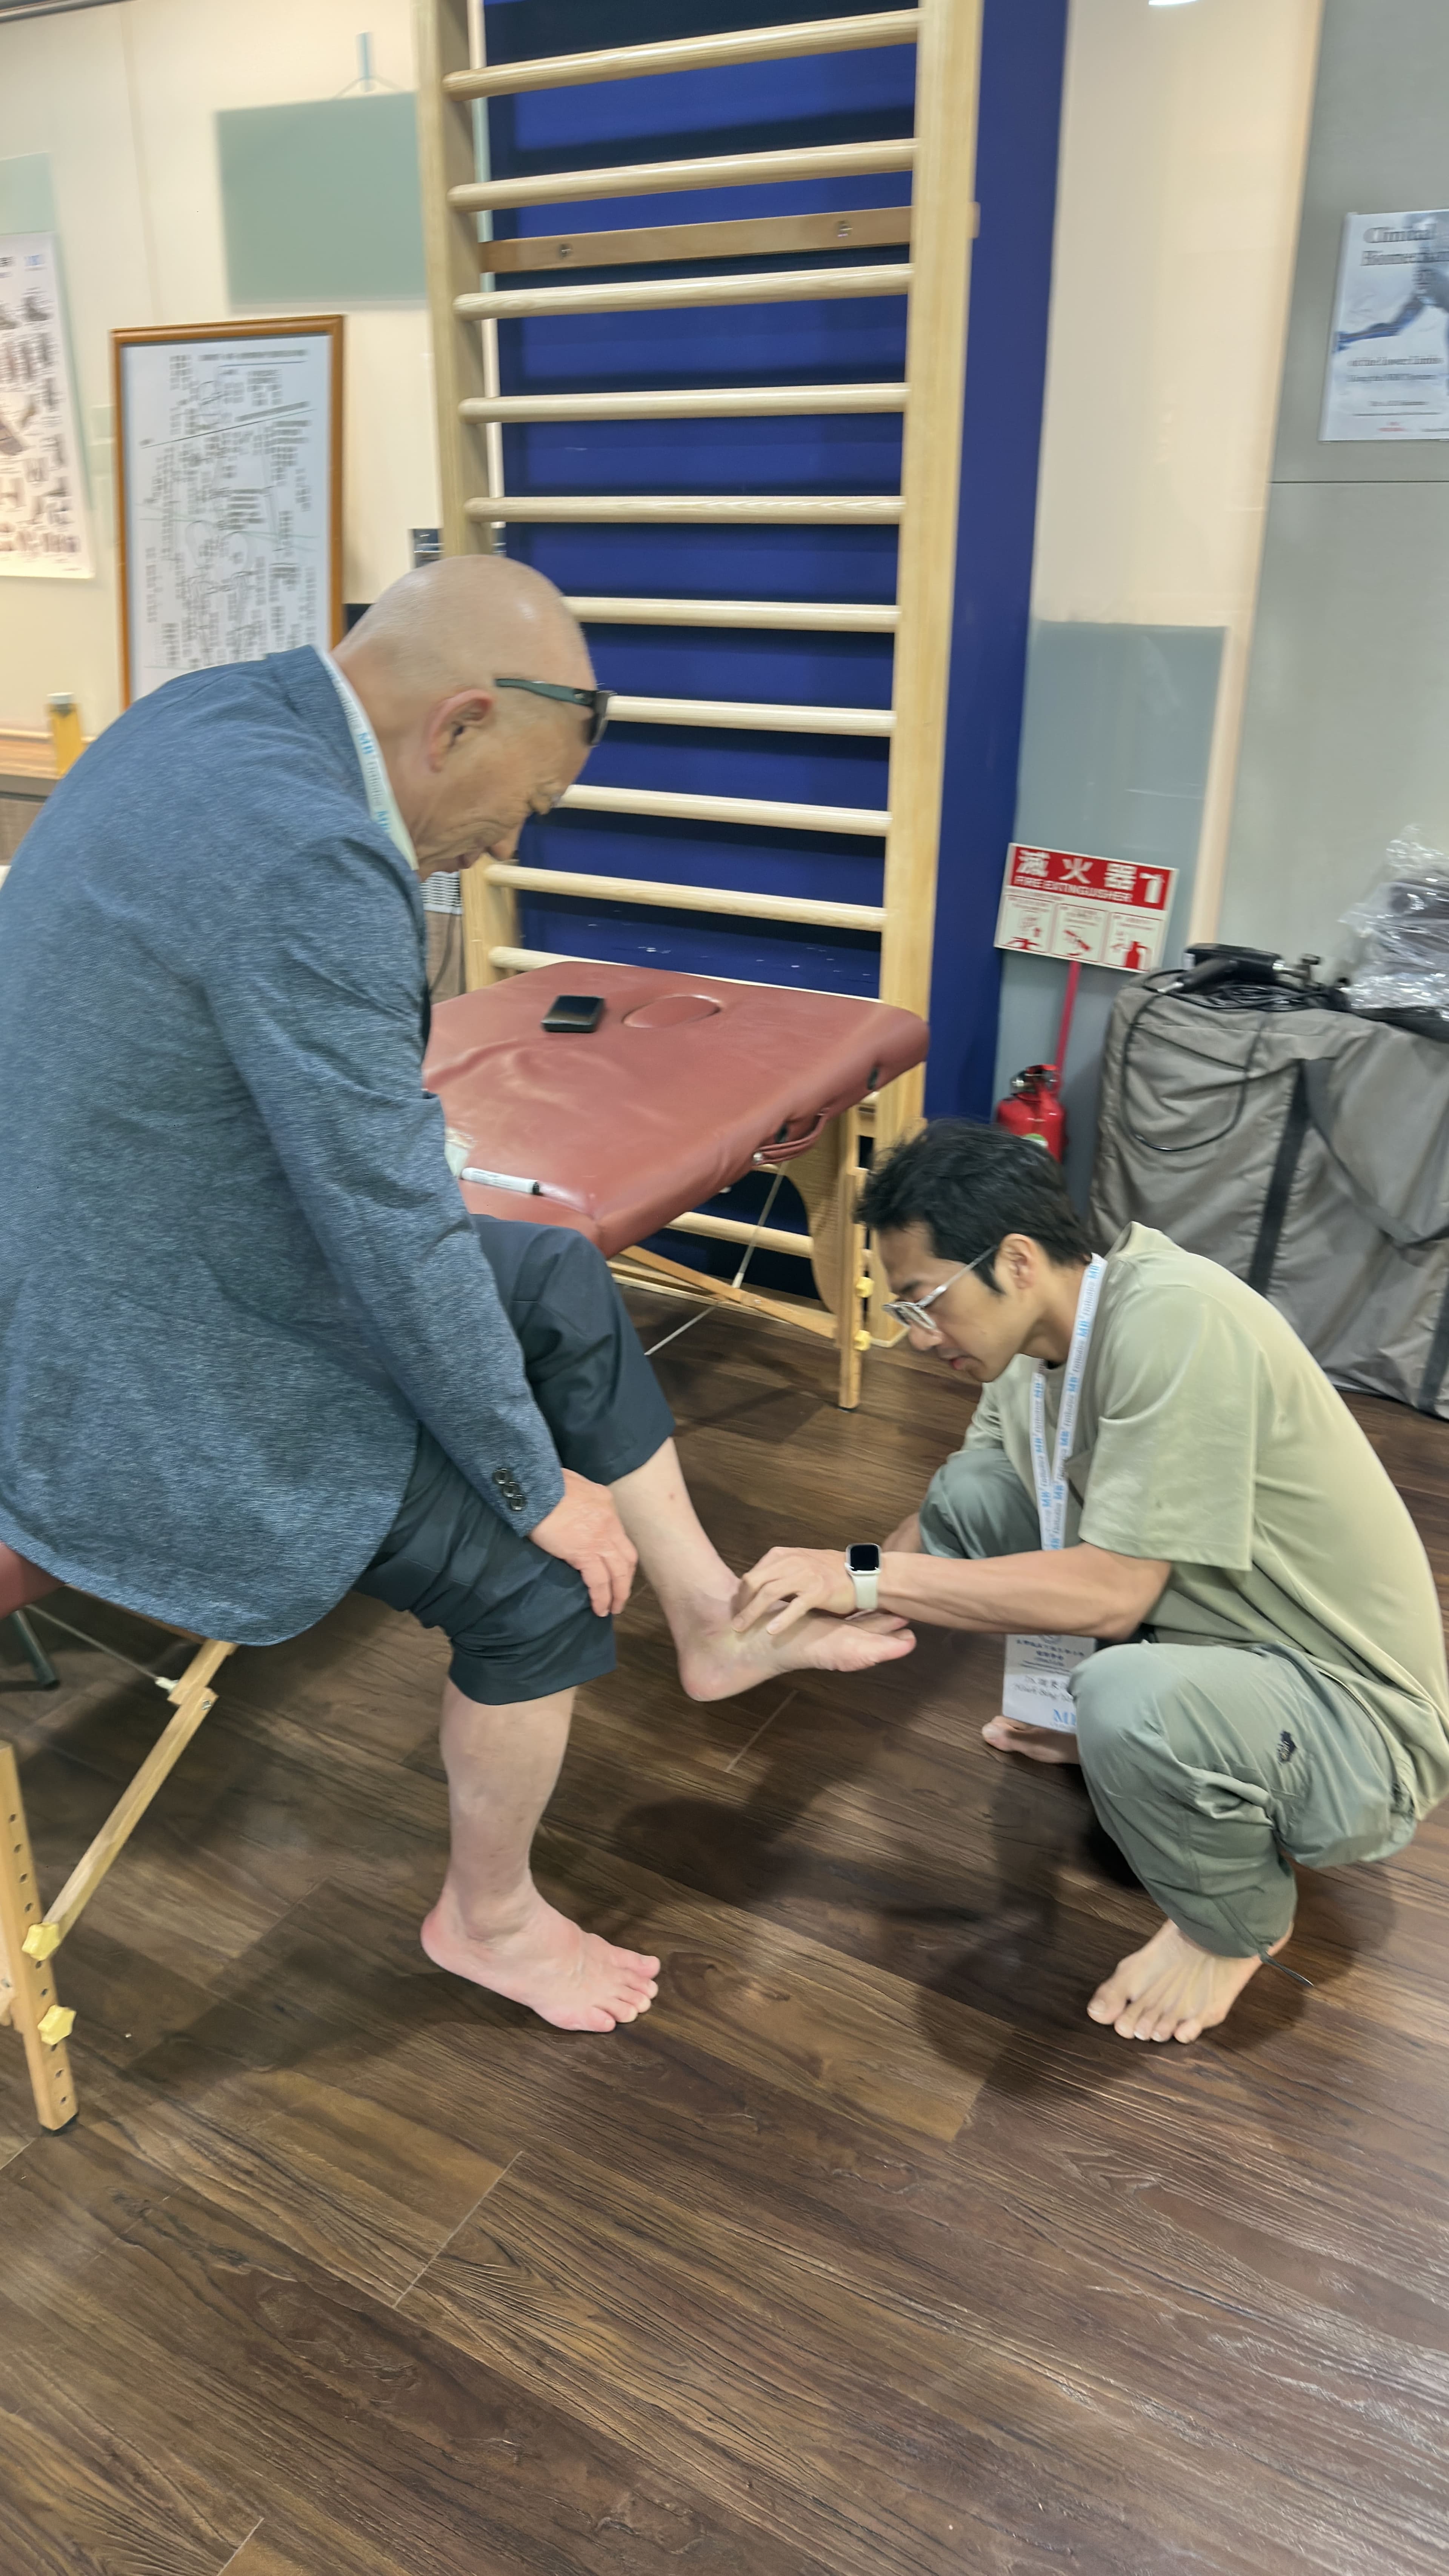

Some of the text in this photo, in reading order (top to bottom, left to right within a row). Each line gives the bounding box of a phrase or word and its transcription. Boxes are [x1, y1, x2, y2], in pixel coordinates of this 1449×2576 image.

[1015, 850, 1137, 890] 滅火器
[1014, 875, 1042, 888] FIRE
[1043, 880, 1133, 902] EXTINGUISHER
